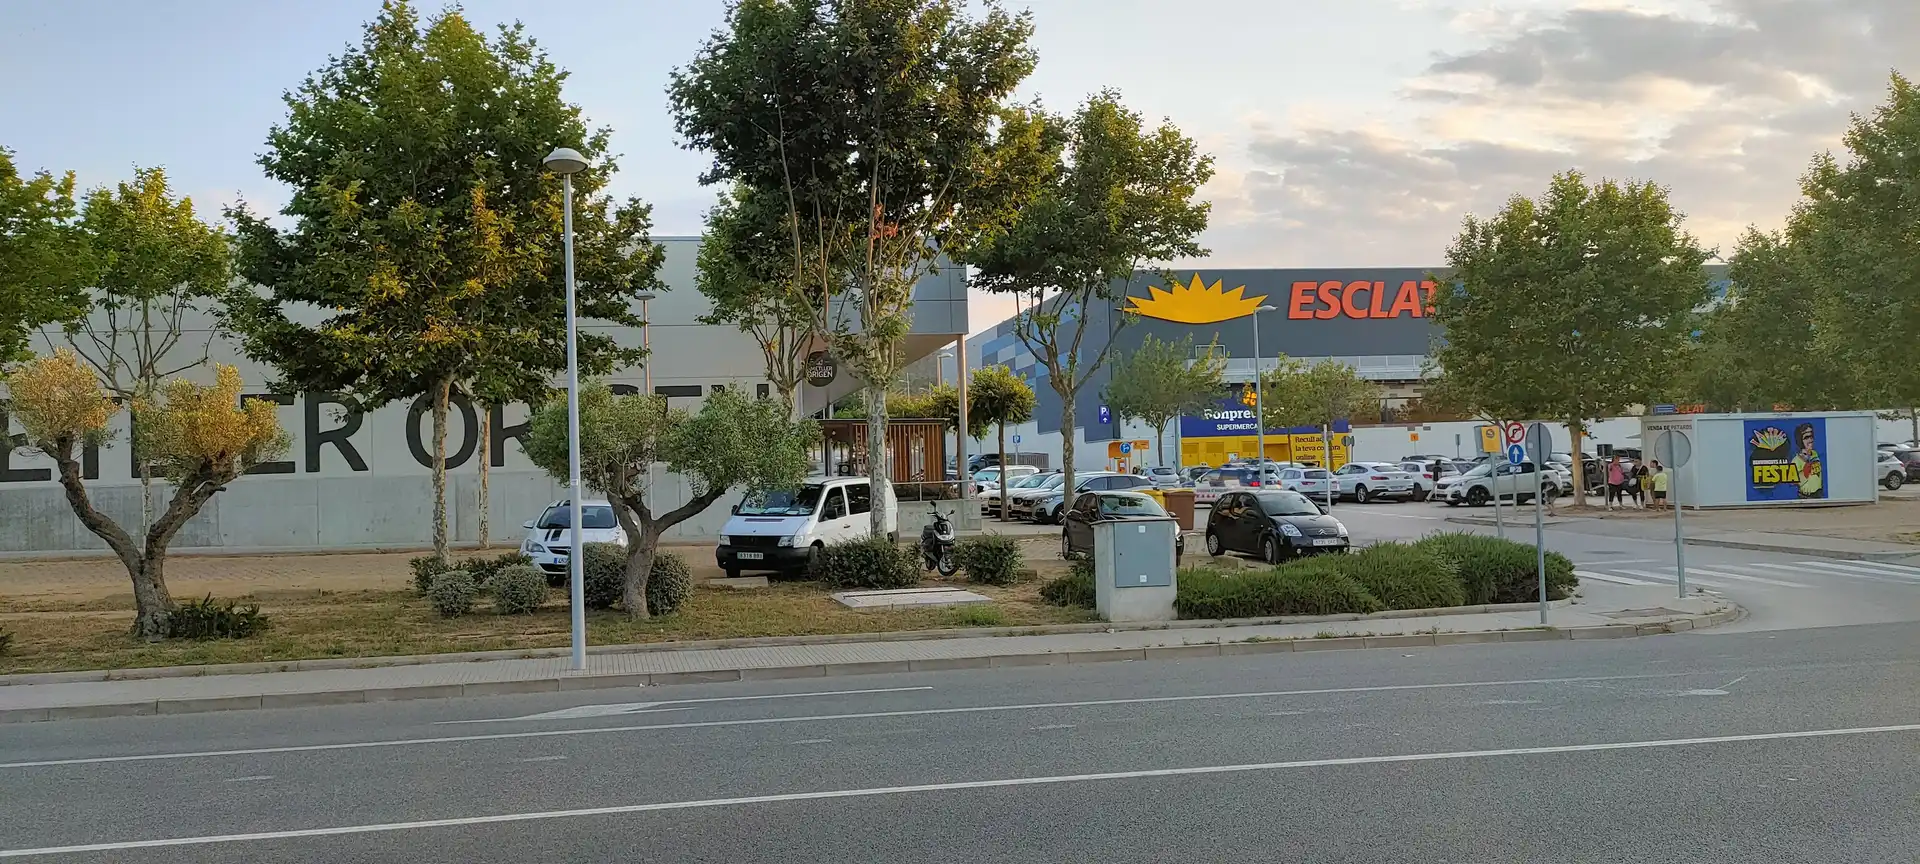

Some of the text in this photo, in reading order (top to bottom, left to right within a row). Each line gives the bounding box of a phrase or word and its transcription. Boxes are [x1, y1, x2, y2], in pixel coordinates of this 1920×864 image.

[1288, 281, 1437, 319] ESCLAT
[1216, 423, 1258, 431] SUPERMERCA
[1753, 465, 1799, 483] FESTA
